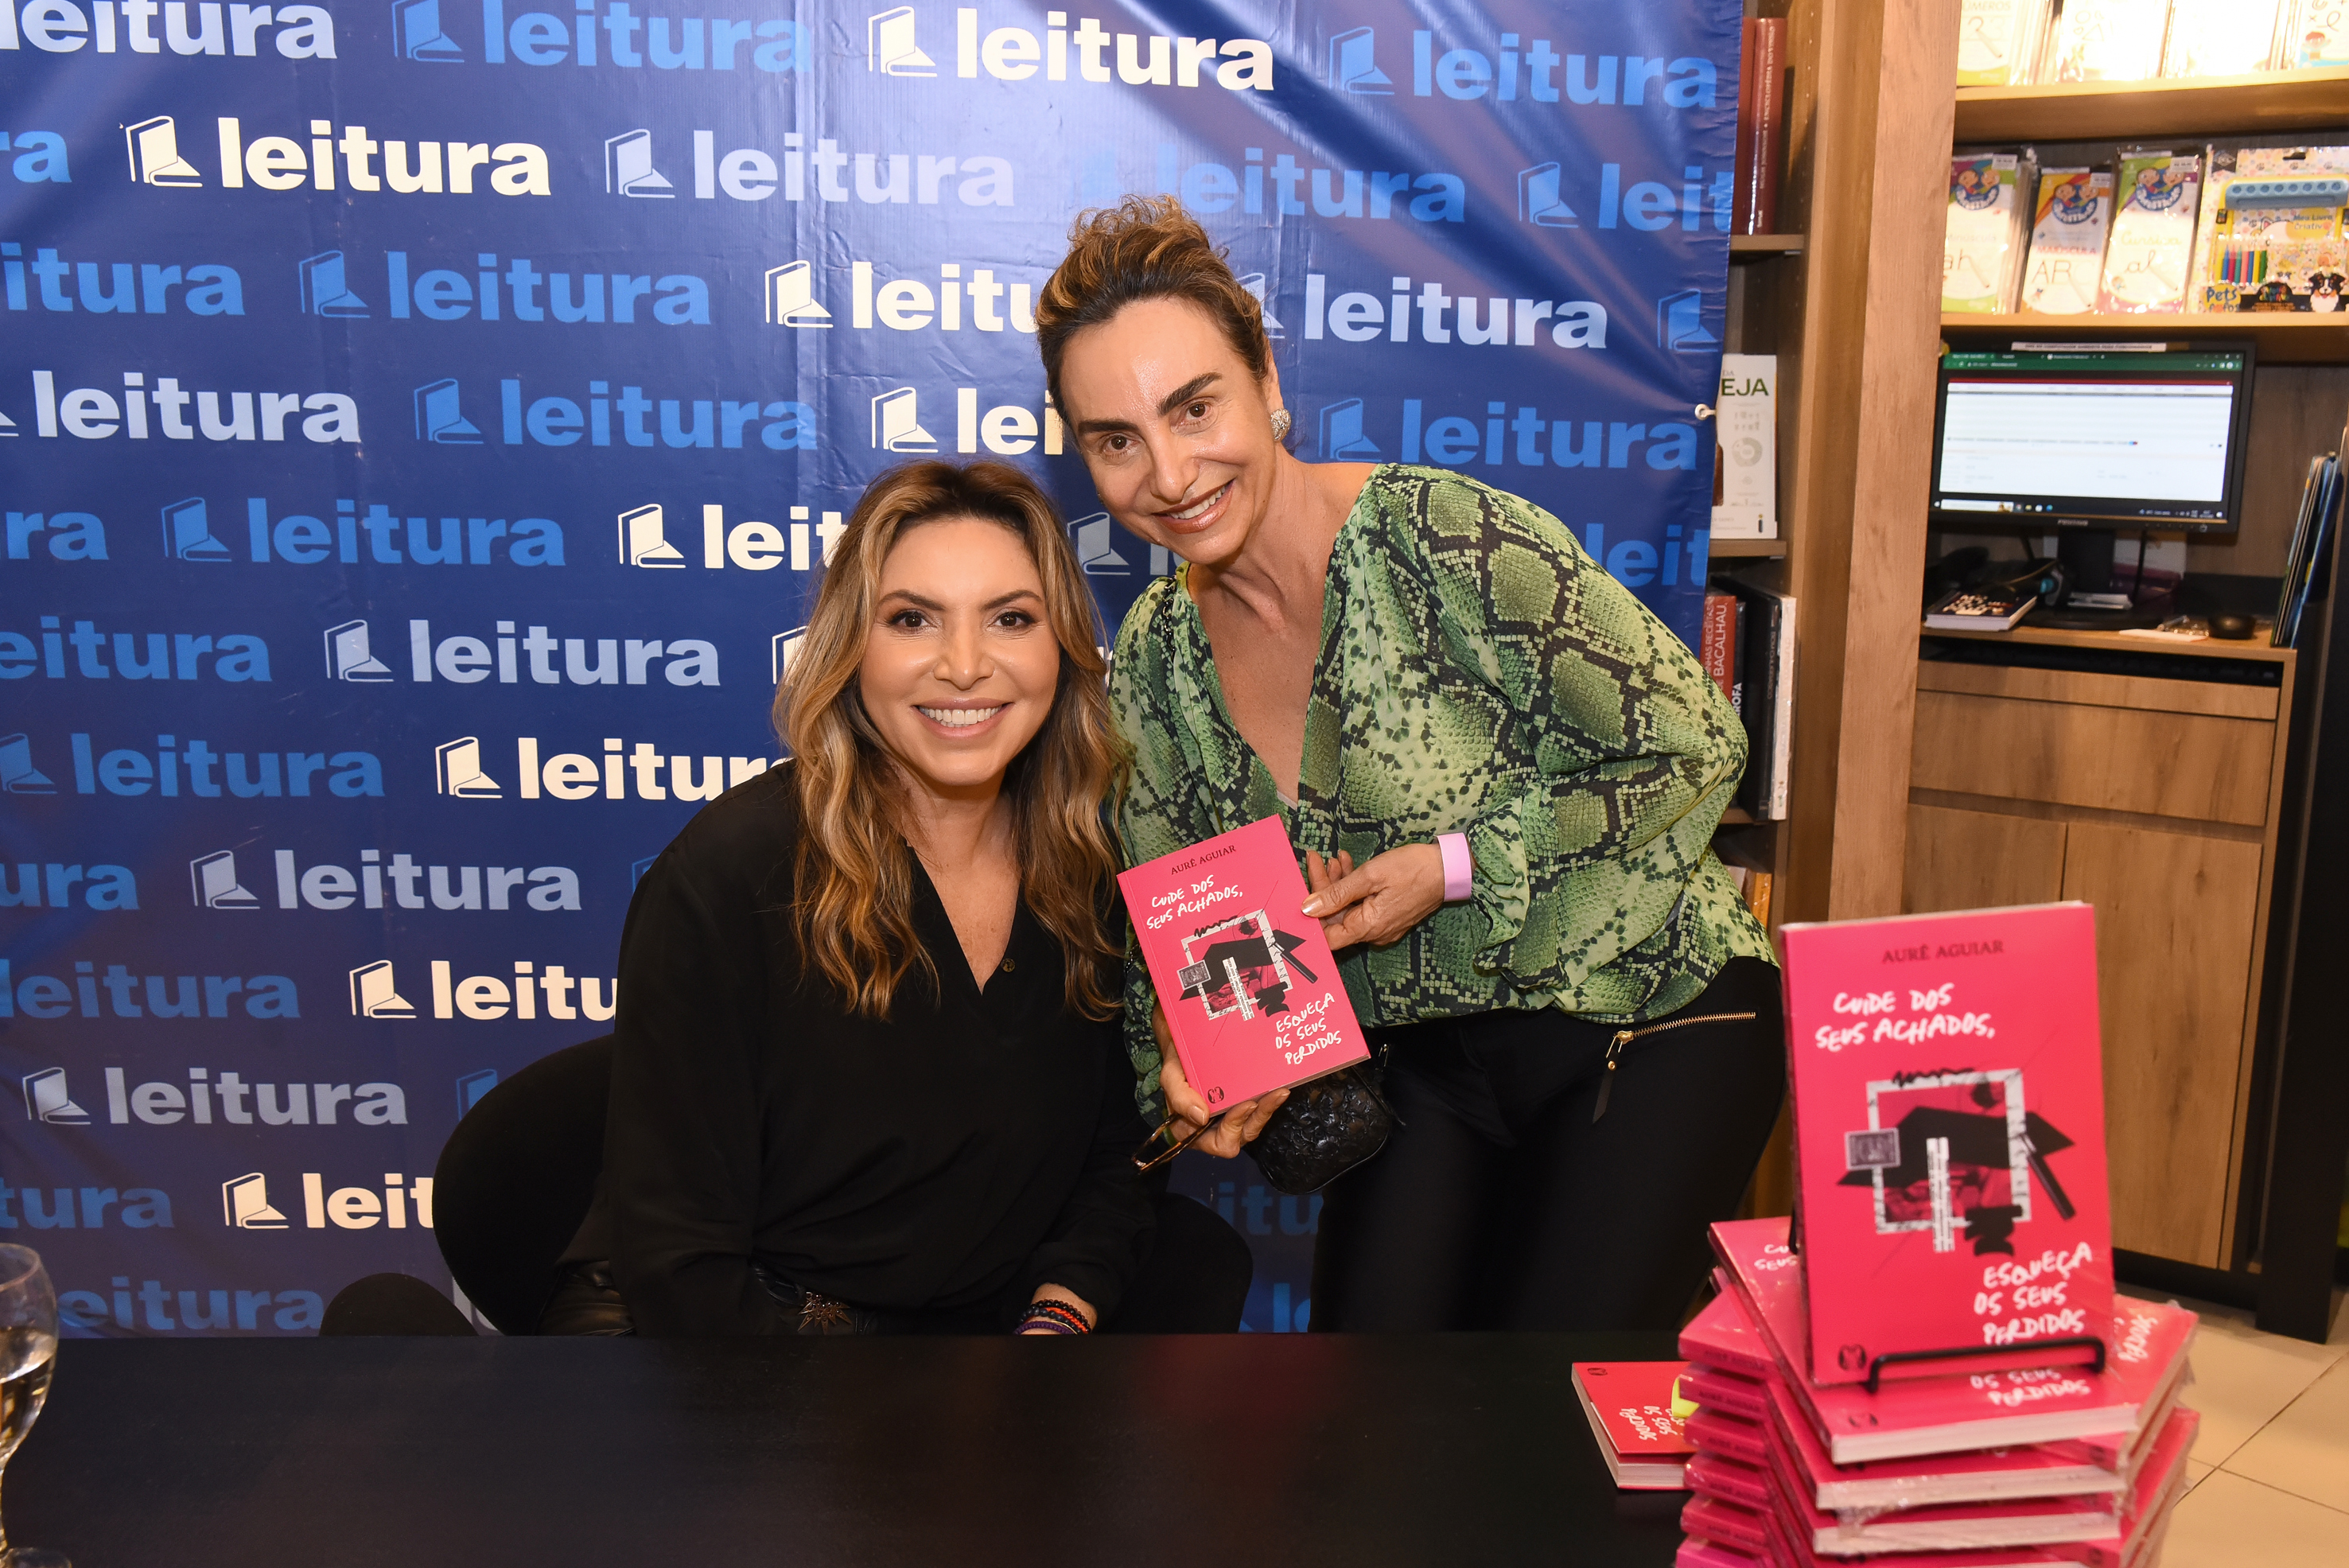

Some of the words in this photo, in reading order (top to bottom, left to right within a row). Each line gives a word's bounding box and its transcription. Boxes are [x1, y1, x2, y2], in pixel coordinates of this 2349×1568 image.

[484, 0, 811, 74] leitura
[957, 7, 1274, 91] leitura
[1414, 29, 1717, 108] leitura
[218, 117, 550, 195] leitura
[694, 130, 1014, 207] leitura
[1156, 142, 1465, 222] leitura
[387, 251, 711, 326] leitura
[1305, 274, 1607, 348] leitura
[2207, 286, 2238, 302] Pets
[33, 370, 361, 443] leitura
[501, 379, 818, 450] leitura
[958, 388, 1064, 455] lei
[1402, 399, 1698, 470] leitura
[247, 498, 566, 566] leitura
[410, 620, 720, 687] leitura
[1731, 683, 1742, 714] ROFA
[71, 733, 385, 797] leitura
[518, 737, 795, 802] leitur
[275, 850, 582, 911] leitura
[1171, 858, 1197, 875] AURÊ
[1198, 844, 1237, 865] AGUIAR
[1146, 910, 1173, 931] SEUS
[1177, 884, 1243, 918] ACHADOS,
[1151, 887, 1185, 909] CUIDE
[1191, 874, 1215, 894] DOS
[1882, 944, 1931, 964] AURÊ
[1935, 940, 2005, 960] AGUIAR
[1276, 993, 1336, 1033] ESQUEÇA
[1833, 990, 1896, 1016] CUIDE
[1909, 982, 1955, 1012] DOS
[1275, 1033, 1292, 1049] OS
[1296, 1017, 1327, 1041] SEUS
[1285, 1030, 1342, 1065] PERDIDOS
[1815, 1021, 1865, 1052] SEUS
[1873, 1013, 1996, 1045] ACHADOS,
[105, 1068, 408, 1125] leitura
[1983, 1241, 2093, 1289] ESQUEÇA
[1974, 1292, 2003, 1316] OS
[2013, 1282, 2067, 1310] SEUS
[1982, 1309, 2086, 1346] PERDIDOS
[1970, 1374, 2000, 1390] OS
[1987, 1379, 2091, 1407] PERDIDOS
